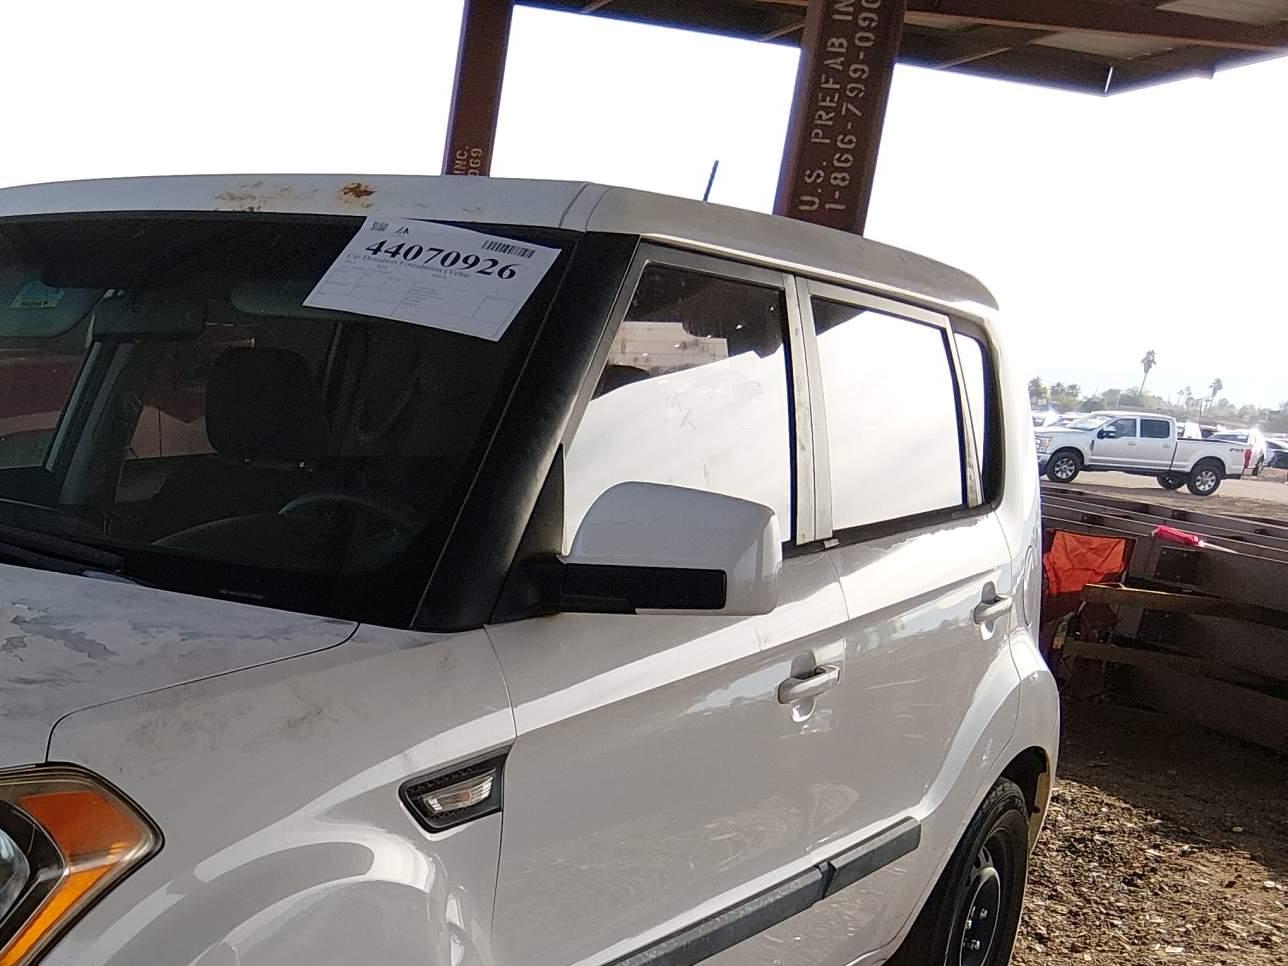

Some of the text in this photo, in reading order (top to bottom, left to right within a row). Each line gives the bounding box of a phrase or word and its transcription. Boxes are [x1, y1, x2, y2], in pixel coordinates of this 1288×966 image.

[811, 37, 848, 143] PREFAB
[454, 146, 469, 174] INC.
[799, 160, 827, 211] U.S.
[365, 239, 521, 280] 44070926
